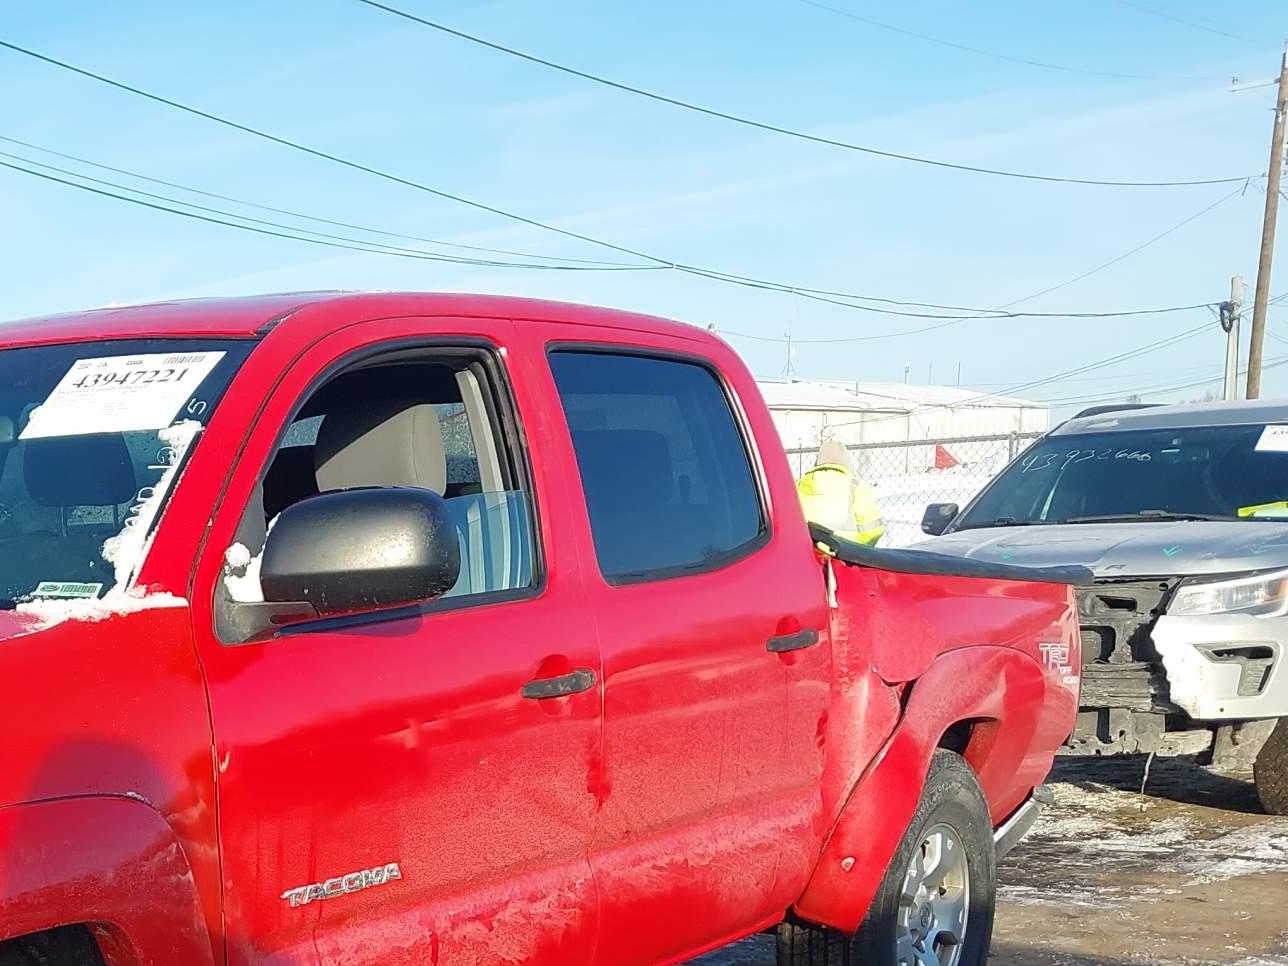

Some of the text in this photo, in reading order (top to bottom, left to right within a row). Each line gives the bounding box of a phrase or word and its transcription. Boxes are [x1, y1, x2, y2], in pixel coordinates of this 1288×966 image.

[72, 367, 190, 389] 43947221
[1038, 643, 1069, 670] TRD
[280, 863, 402, 907] TACOMA
